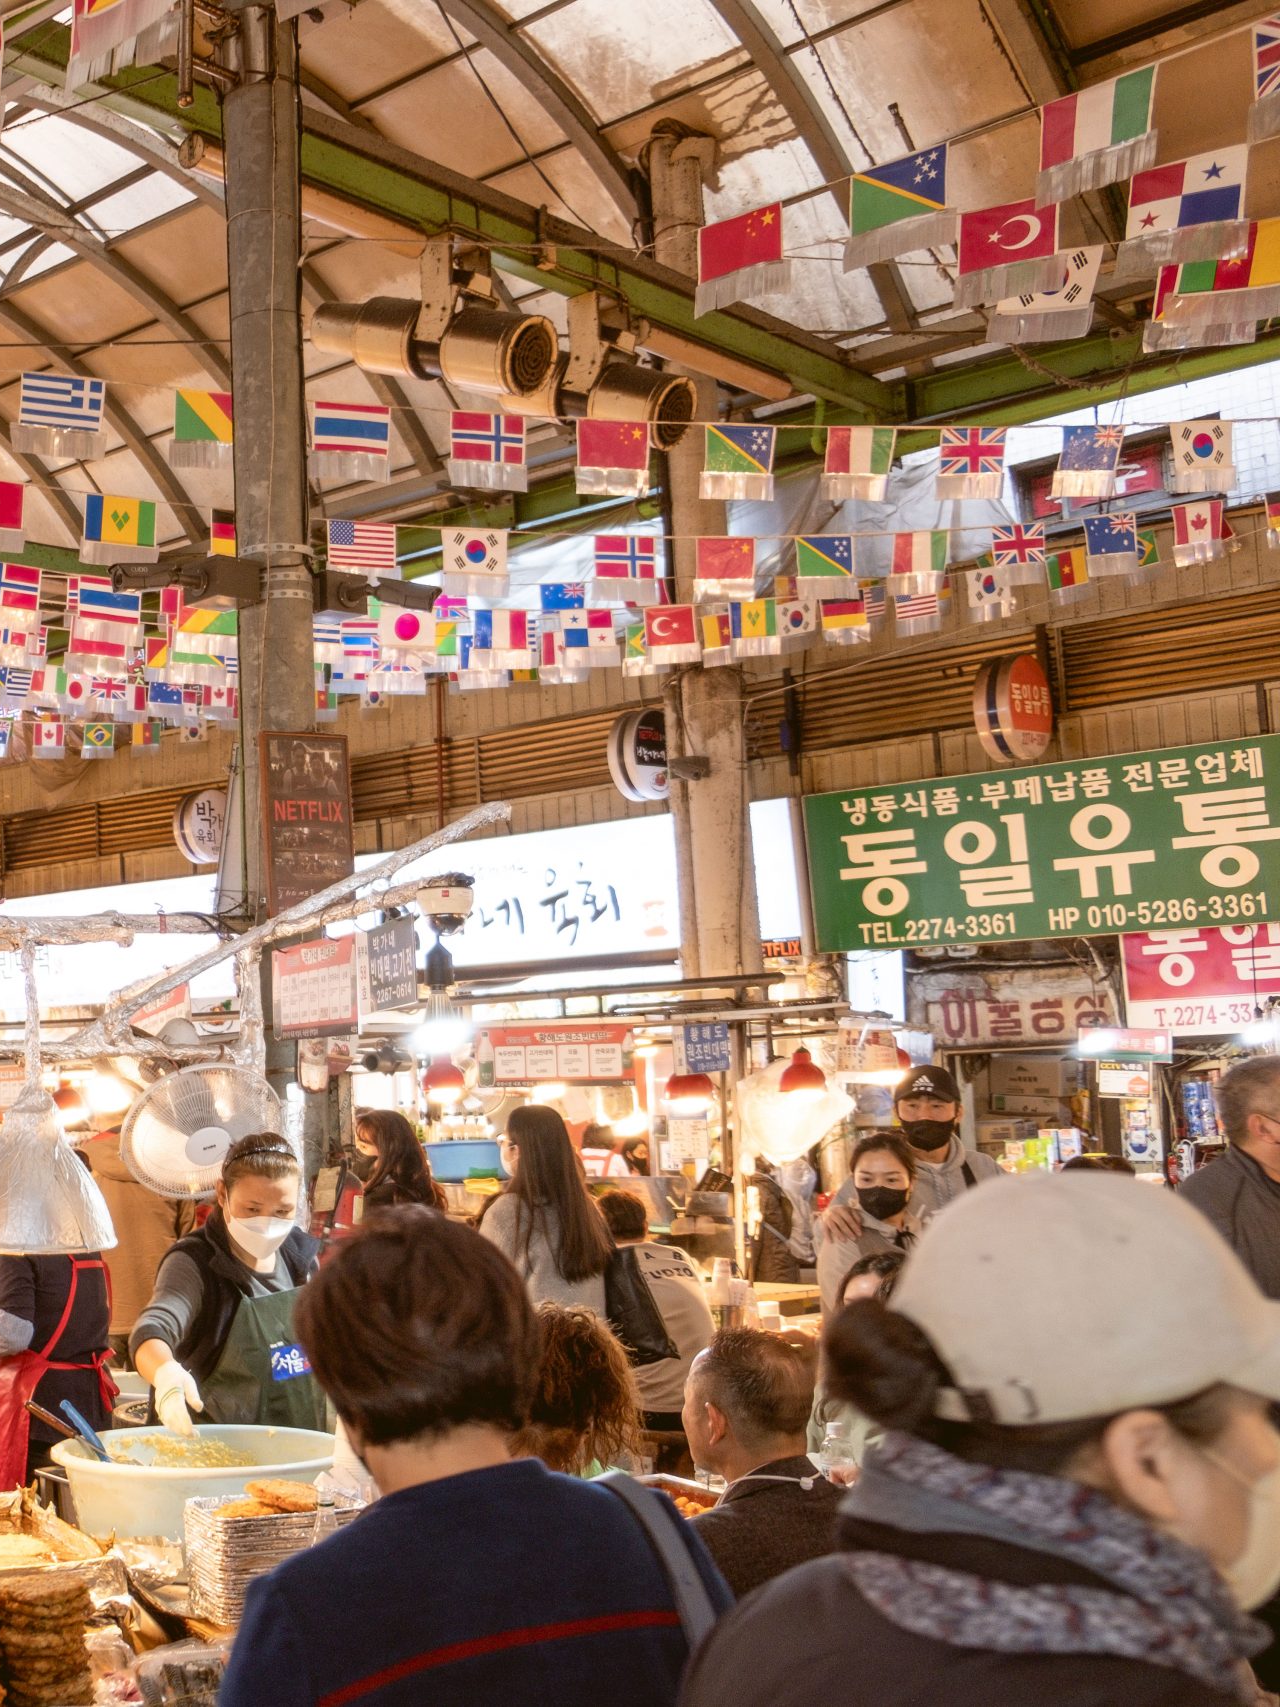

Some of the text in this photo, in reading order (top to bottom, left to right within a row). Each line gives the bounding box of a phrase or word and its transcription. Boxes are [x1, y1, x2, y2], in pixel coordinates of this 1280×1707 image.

[1011, 683, 1048, 717] 동일유통
[1122, 747, 1265, 793] 전문업체
[274, 800, 343, 823] NETFLIX
[196, 829, 217, 845] 육회
[840, 785, 1280, 917] 동일유통
[539, 862, 621, 946] 육회
[1048, 891, 1268, 930] HP 010-5286-3361
[858, 911, 1017, 945] TEL.2274-3361
[372, 930, 396, 952] 박가네
[761, 940, 800, 957] TFLIX
[377, 981, 412, 1004] 2267-0614
[1154, 1002, 1253, 1028] T.2274-33
[690, 1025, 724, 1042] 황해도
[1100, 1062, 1120, 1070] CCTV
[644, 1252, 656, 1260] A
[642, 1267, 694, 1279] UDIO
[277, 1348, 304, 1375] 서울
